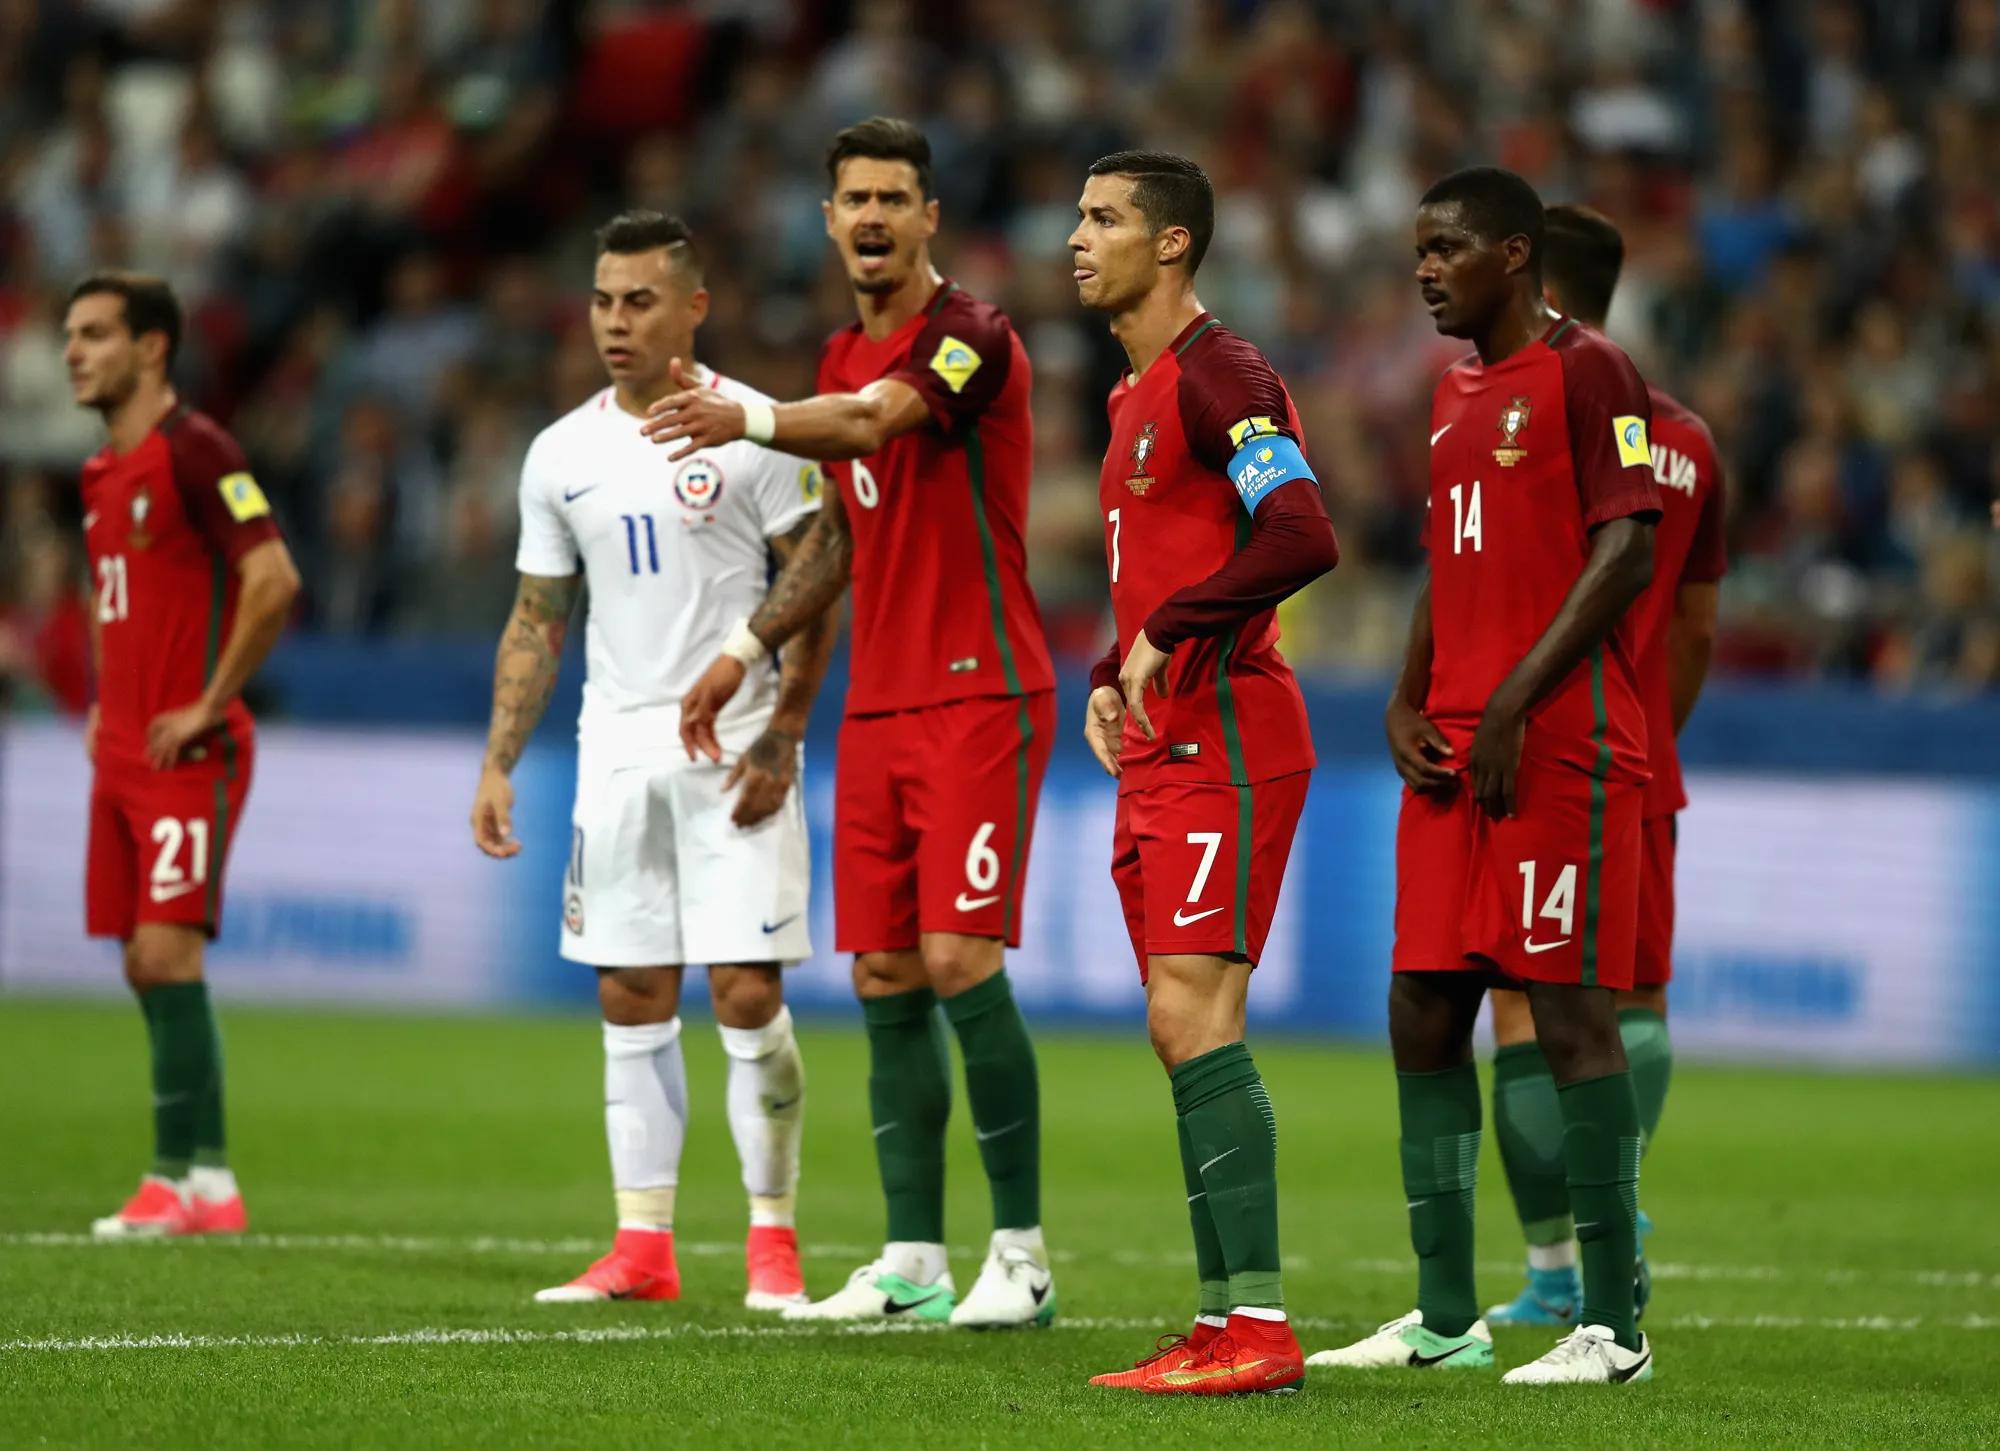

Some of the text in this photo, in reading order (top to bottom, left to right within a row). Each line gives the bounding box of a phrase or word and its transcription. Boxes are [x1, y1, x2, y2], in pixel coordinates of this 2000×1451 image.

[851, 457, 879, 509] 6
[1235, 463, 1260, 496] IFA
[1247, 466, 1276, 493] MY GAME
[1254, 478, 1269, 492] FAIR
[1269, 467, 1287, 480] PLAY
[1649, 443, 1697, 498] ILVA
[620, 514, 660, 575] 11
[1108, 507, 1121, 583] 7
[1449, 480, 1482, 555] 14
[97, 552, 129, 623] 21
[150, 815, 209, 884] 21
[965, 822, 1000, 892] 6
[1185, 832, 1223, 903] 7
[1518, 859, 1578, 936] 14
